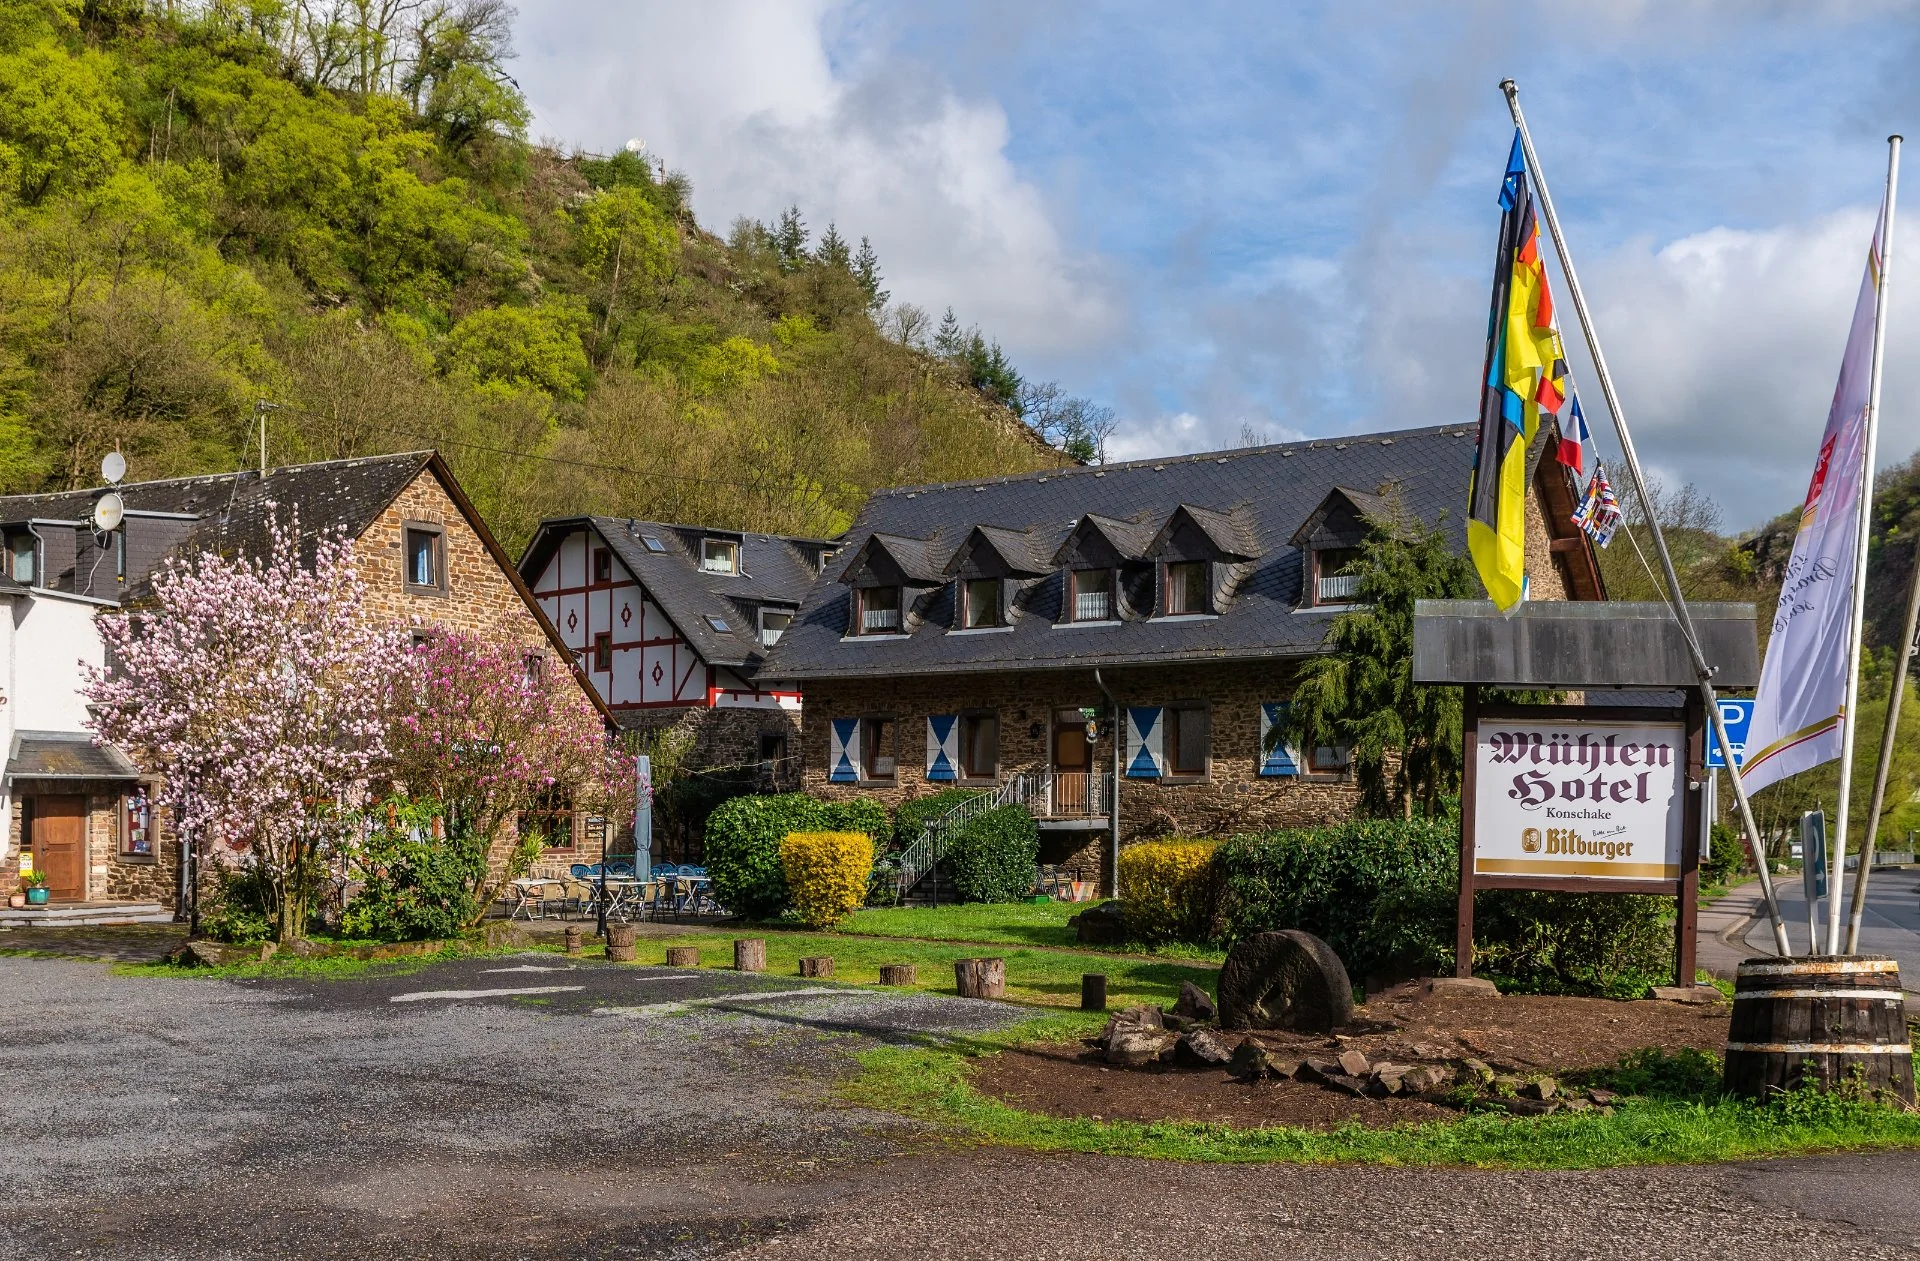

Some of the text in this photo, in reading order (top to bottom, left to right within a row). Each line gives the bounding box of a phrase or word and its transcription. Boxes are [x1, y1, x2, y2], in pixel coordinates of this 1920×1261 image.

[1720, 705, 1745, 725] P
[1489, 732, 1672, 775] Mühlen
[1508, 769, 1652, 811] Hotel
[1546, 807, 1612, 820] Konschake
[1544, 827, 1634, 860] Bitburger
